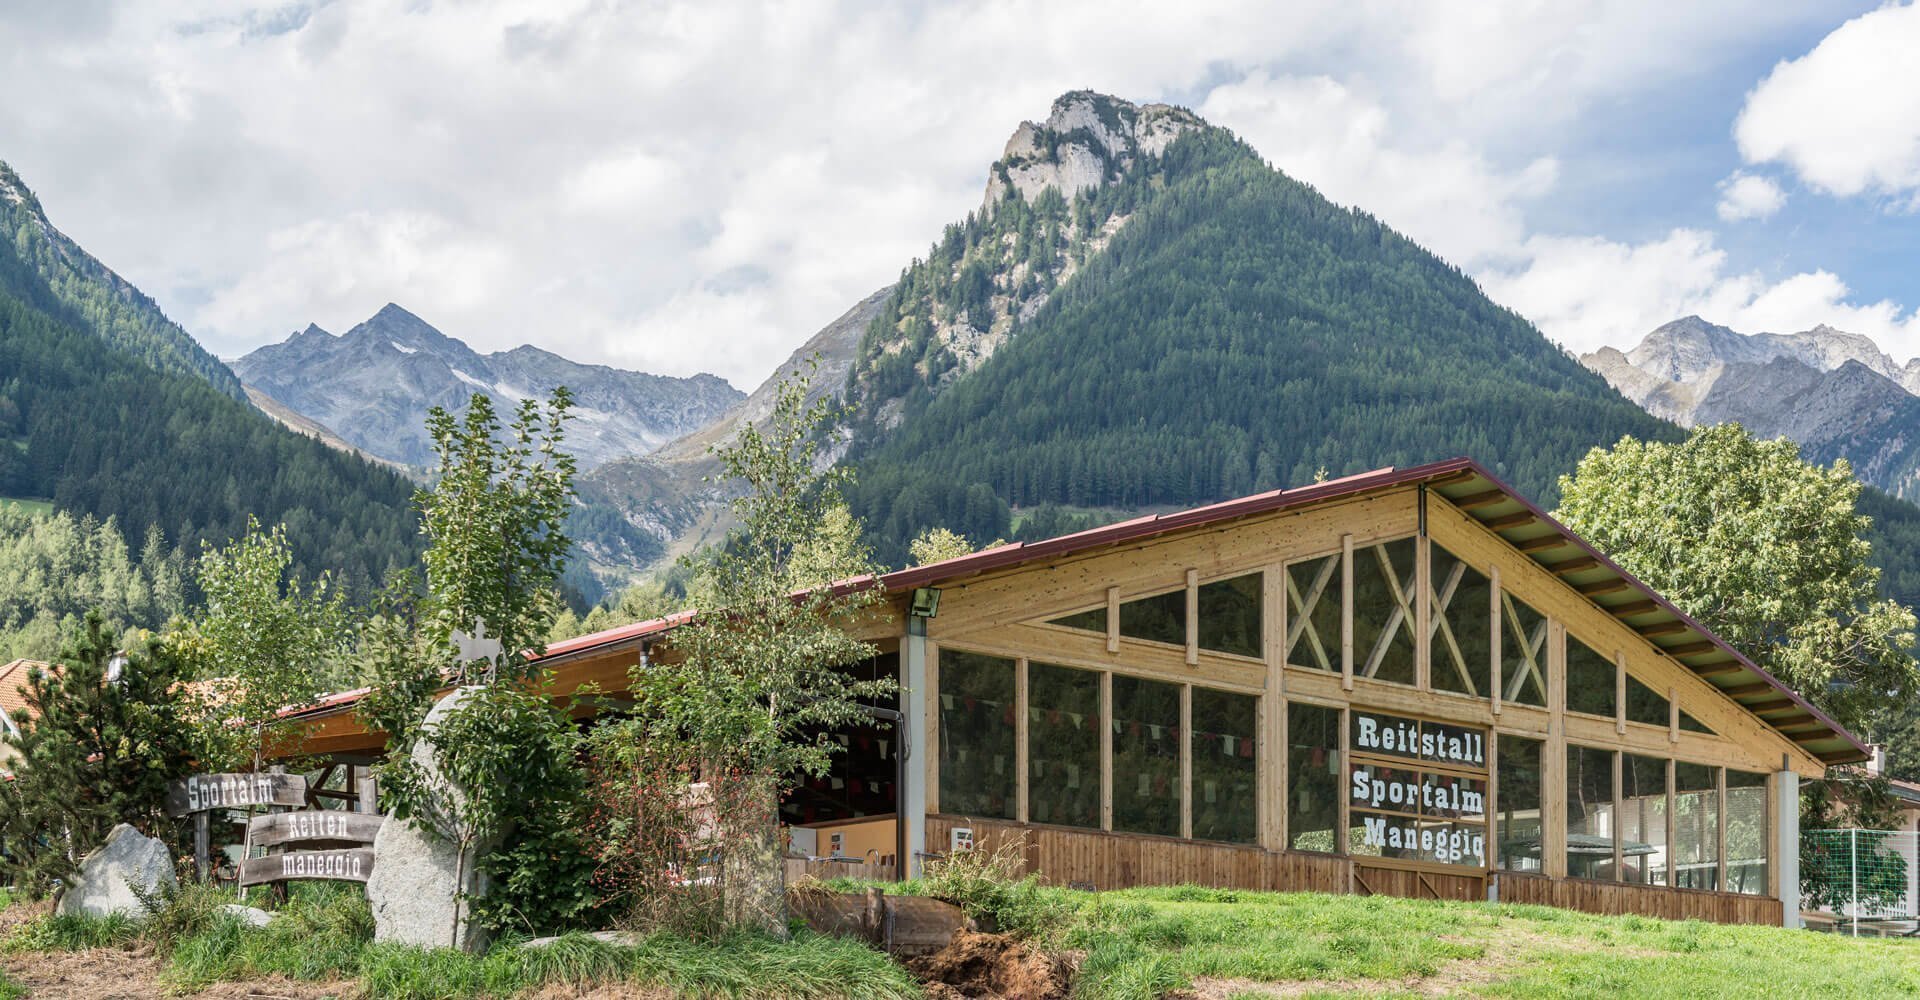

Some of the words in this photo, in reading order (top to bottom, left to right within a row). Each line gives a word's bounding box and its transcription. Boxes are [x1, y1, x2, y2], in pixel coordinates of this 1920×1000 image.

[1358, 717, 1483, 763] Reitstall
[188, 776, 274, 809] Sportalm
[1353, 770, 1483, 813] Sportalm
[288, 814, 347, 838] Reiten
[1364, 817, 1484, 862] Maneggio
[282, 854, 361, 877] maneggio
